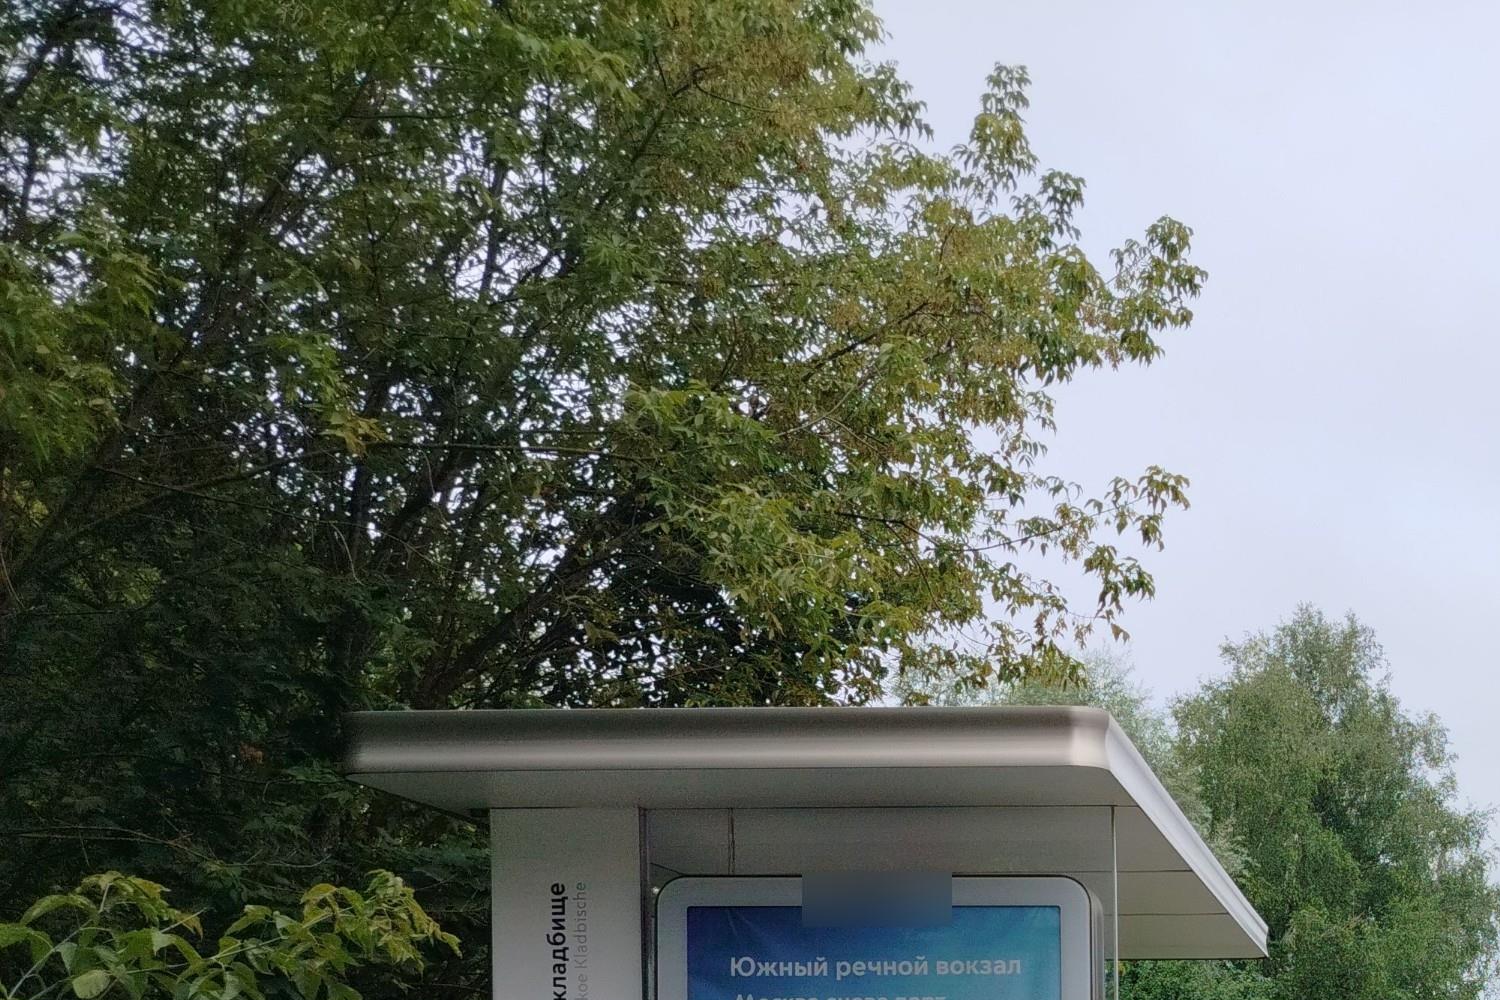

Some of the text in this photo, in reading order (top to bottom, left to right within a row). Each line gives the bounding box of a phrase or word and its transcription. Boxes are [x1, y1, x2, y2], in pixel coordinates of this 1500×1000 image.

[572, 882, 588, 969] Kladbische
[730, 956, 1021, 980] Южный речной вокзал
